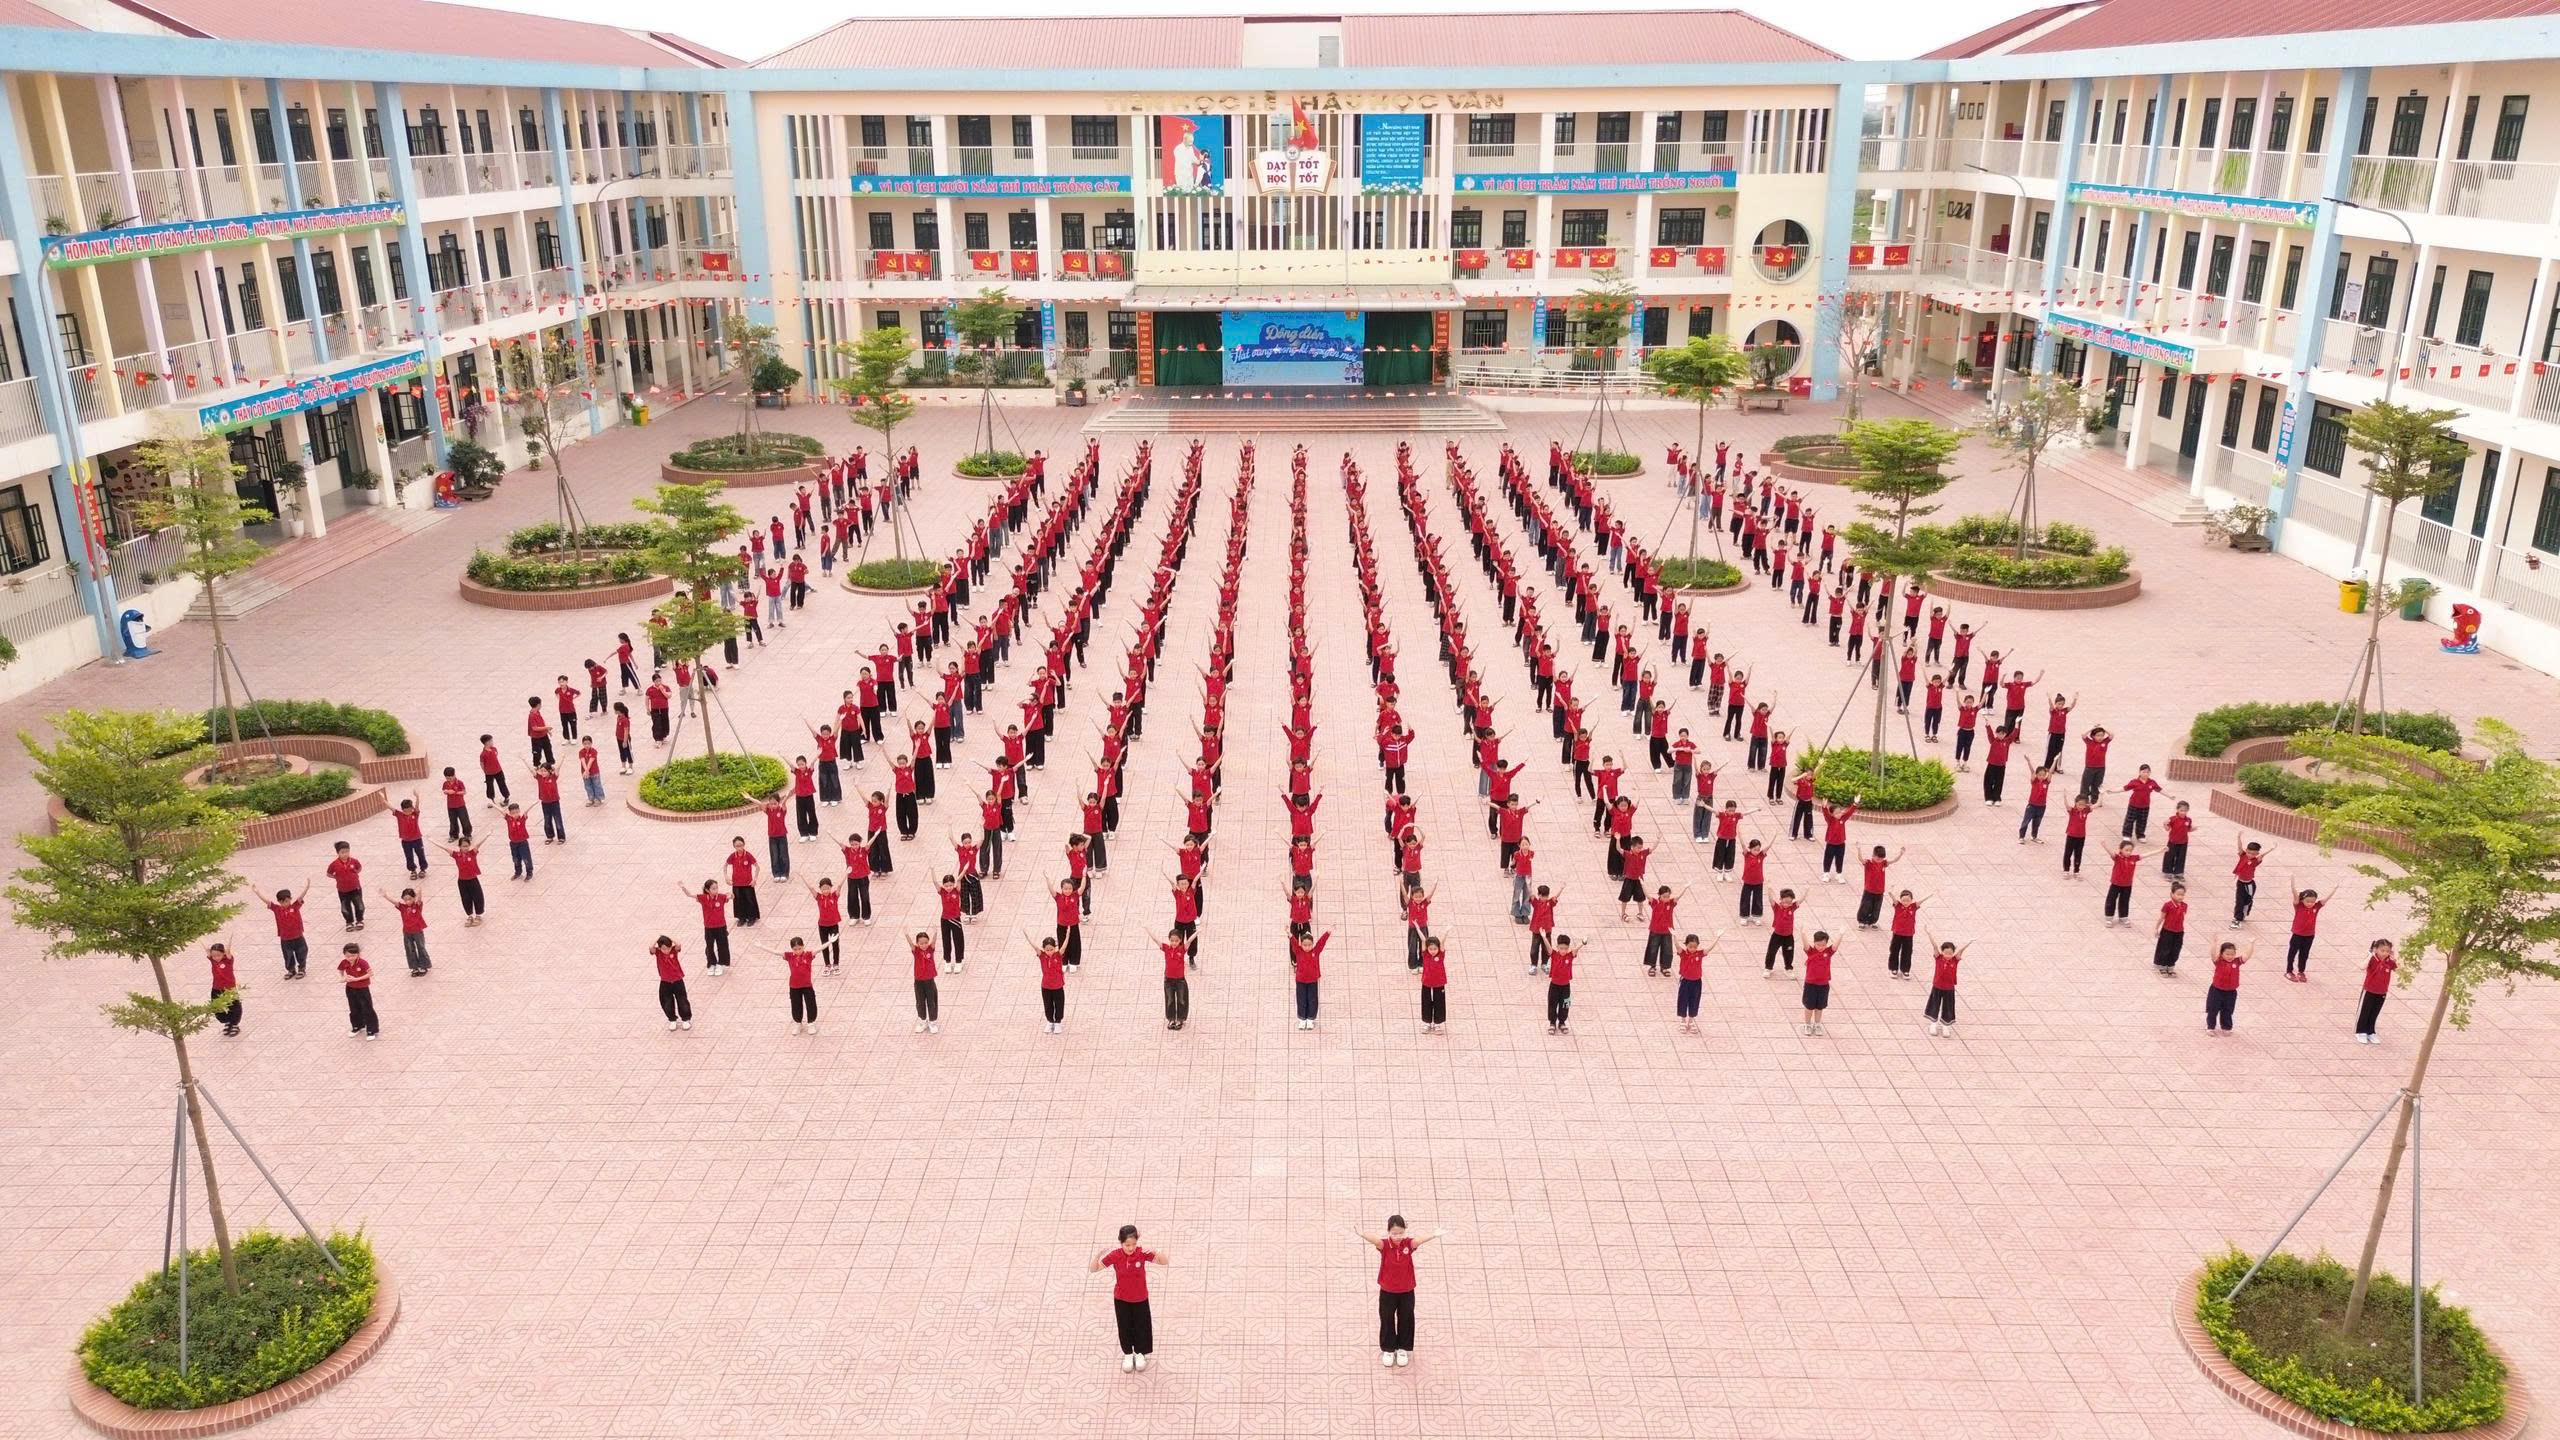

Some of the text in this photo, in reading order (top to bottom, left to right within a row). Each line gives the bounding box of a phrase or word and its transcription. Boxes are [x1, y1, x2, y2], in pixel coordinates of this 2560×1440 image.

[1300, 92, 1361, 113] HẬU
[1447, 91, 1504, 110] VĂN
[1267, 156, 1319, 173] DẠY TỐT
[917, 179, 936, 192] ÍCH
[939, 180, 969, 193] MƯỜI
[971, 180, 998, 193] NĂM
[1023, 179, 1050, 193] PHẢI
[1267, 171, 1318, 185] HỌC TỐT
[1517, 178, 1536, 191] ÍCH
[1538, 176, 1568, 190] TRĂM
[1572, 176, 1595, 190] NĂM
[1620, 175, 1646, 190] PHẢI
[1688, 175, 1723, 189] NGƯỜI
[64, 239, 90, 261] HÔM
[114, 233, 134, 255] CÁC
[134, 234, 151, 252] EM
[150, 231, 165, 253] TỰ
[165, 228, 184, 249] HÀO
[196, 224, 215, 245] NHÀ
[215, 221, 249, 242] TRƯỜNG
[253, 219, 274, 238] NGÀY
[292, 214, 308, 232] NHÀ
[252, 400, 264, 418] CÔ
[263, 397, 281, 415] THÂN
